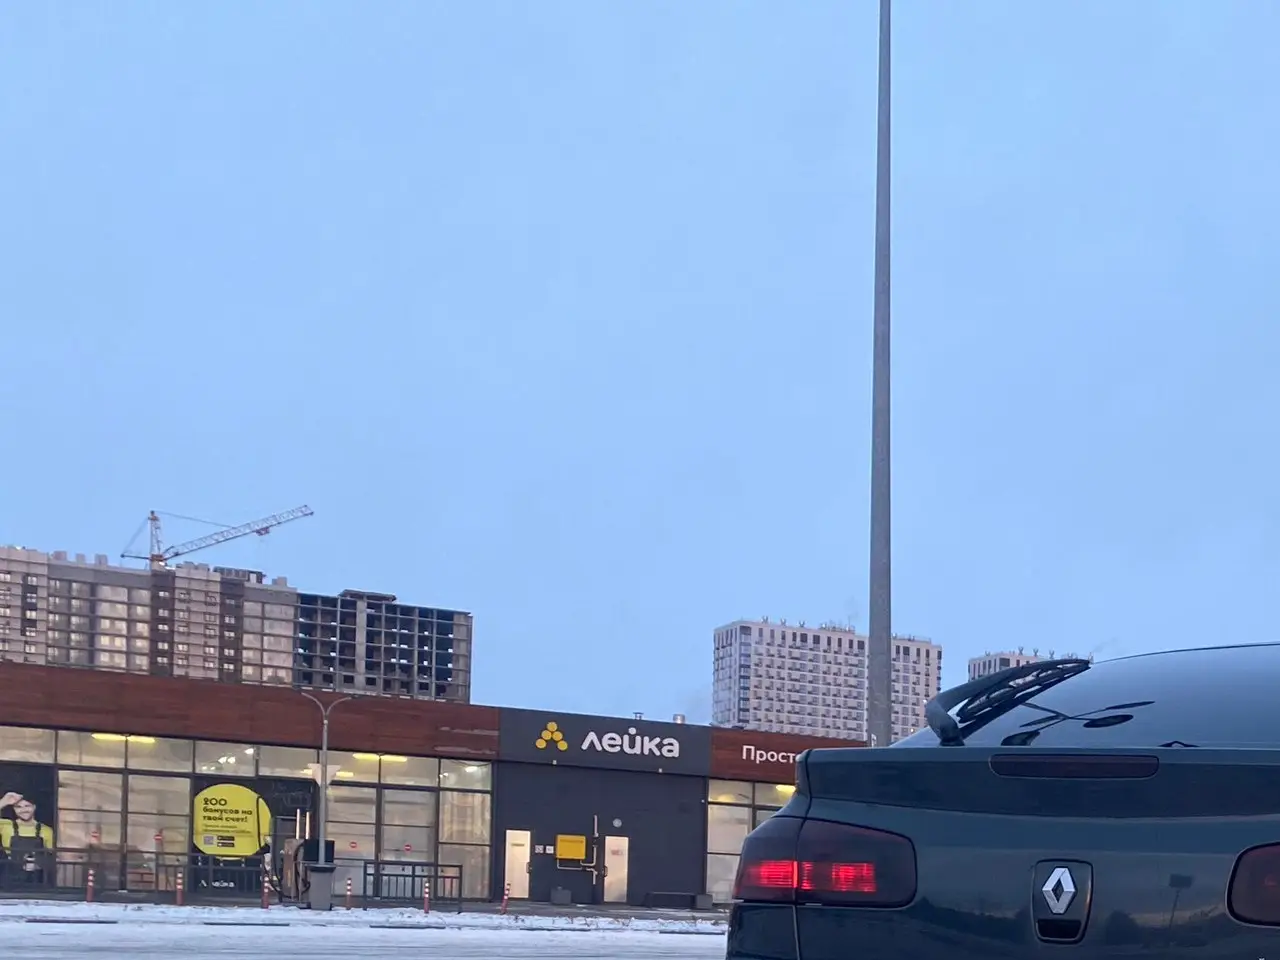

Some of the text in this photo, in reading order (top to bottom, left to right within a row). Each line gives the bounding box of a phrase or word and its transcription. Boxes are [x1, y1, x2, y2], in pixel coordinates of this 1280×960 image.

[581, 727, 680, 758] лейка
[742, 745, 797, 764] Прост
[203, 797, 228, 806] 200
